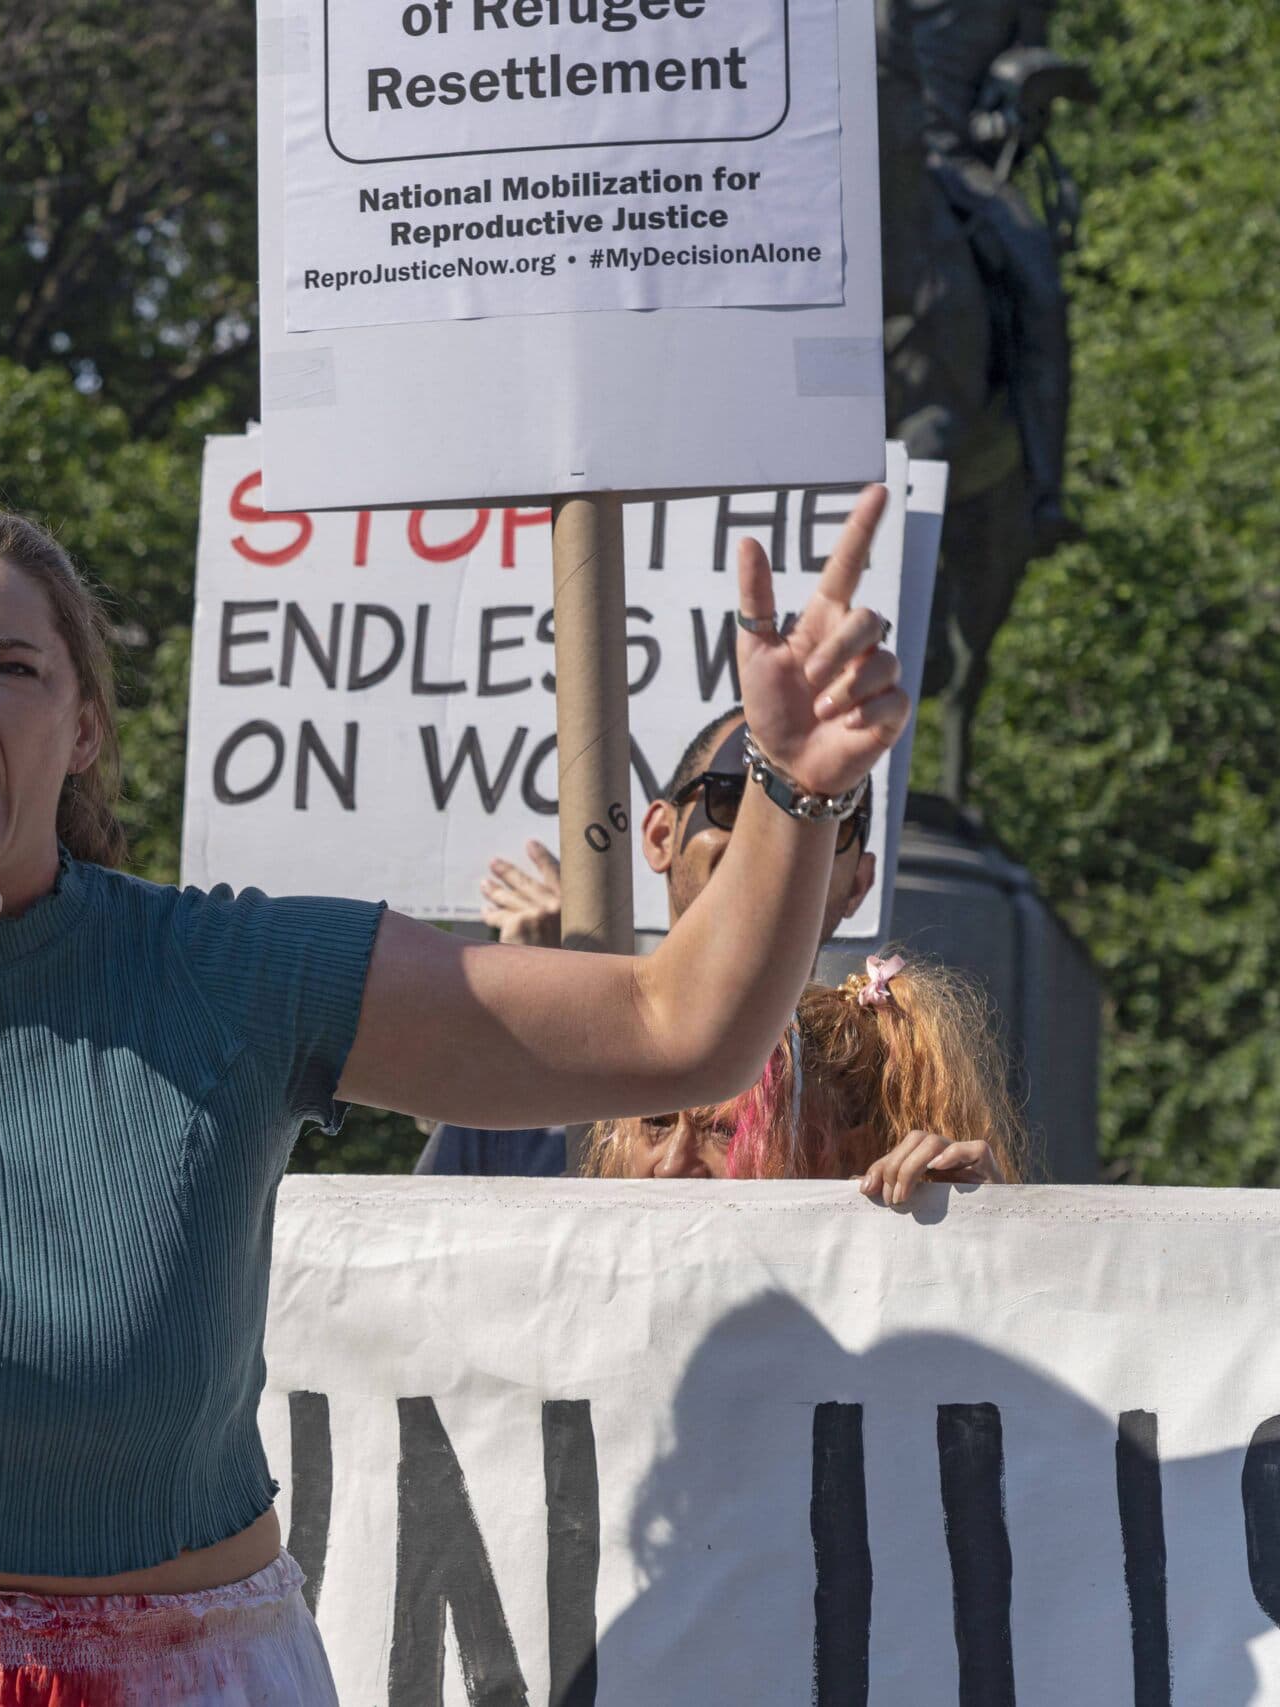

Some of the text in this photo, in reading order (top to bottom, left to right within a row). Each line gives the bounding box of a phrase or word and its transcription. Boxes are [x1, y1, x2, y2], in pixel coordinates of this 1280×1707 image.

[401, 0, 706, 37] of Refugee
[367, 46, 748, 112] Resettlement
[359, 166, 761, 213] National Mobilization for
[390, 204, 728, 248] Reproductive Justice
[304, 243, 821, 291] ReproJusticeNow.org #MyDecisionAlone
[212, 719, 358, 812] ON
